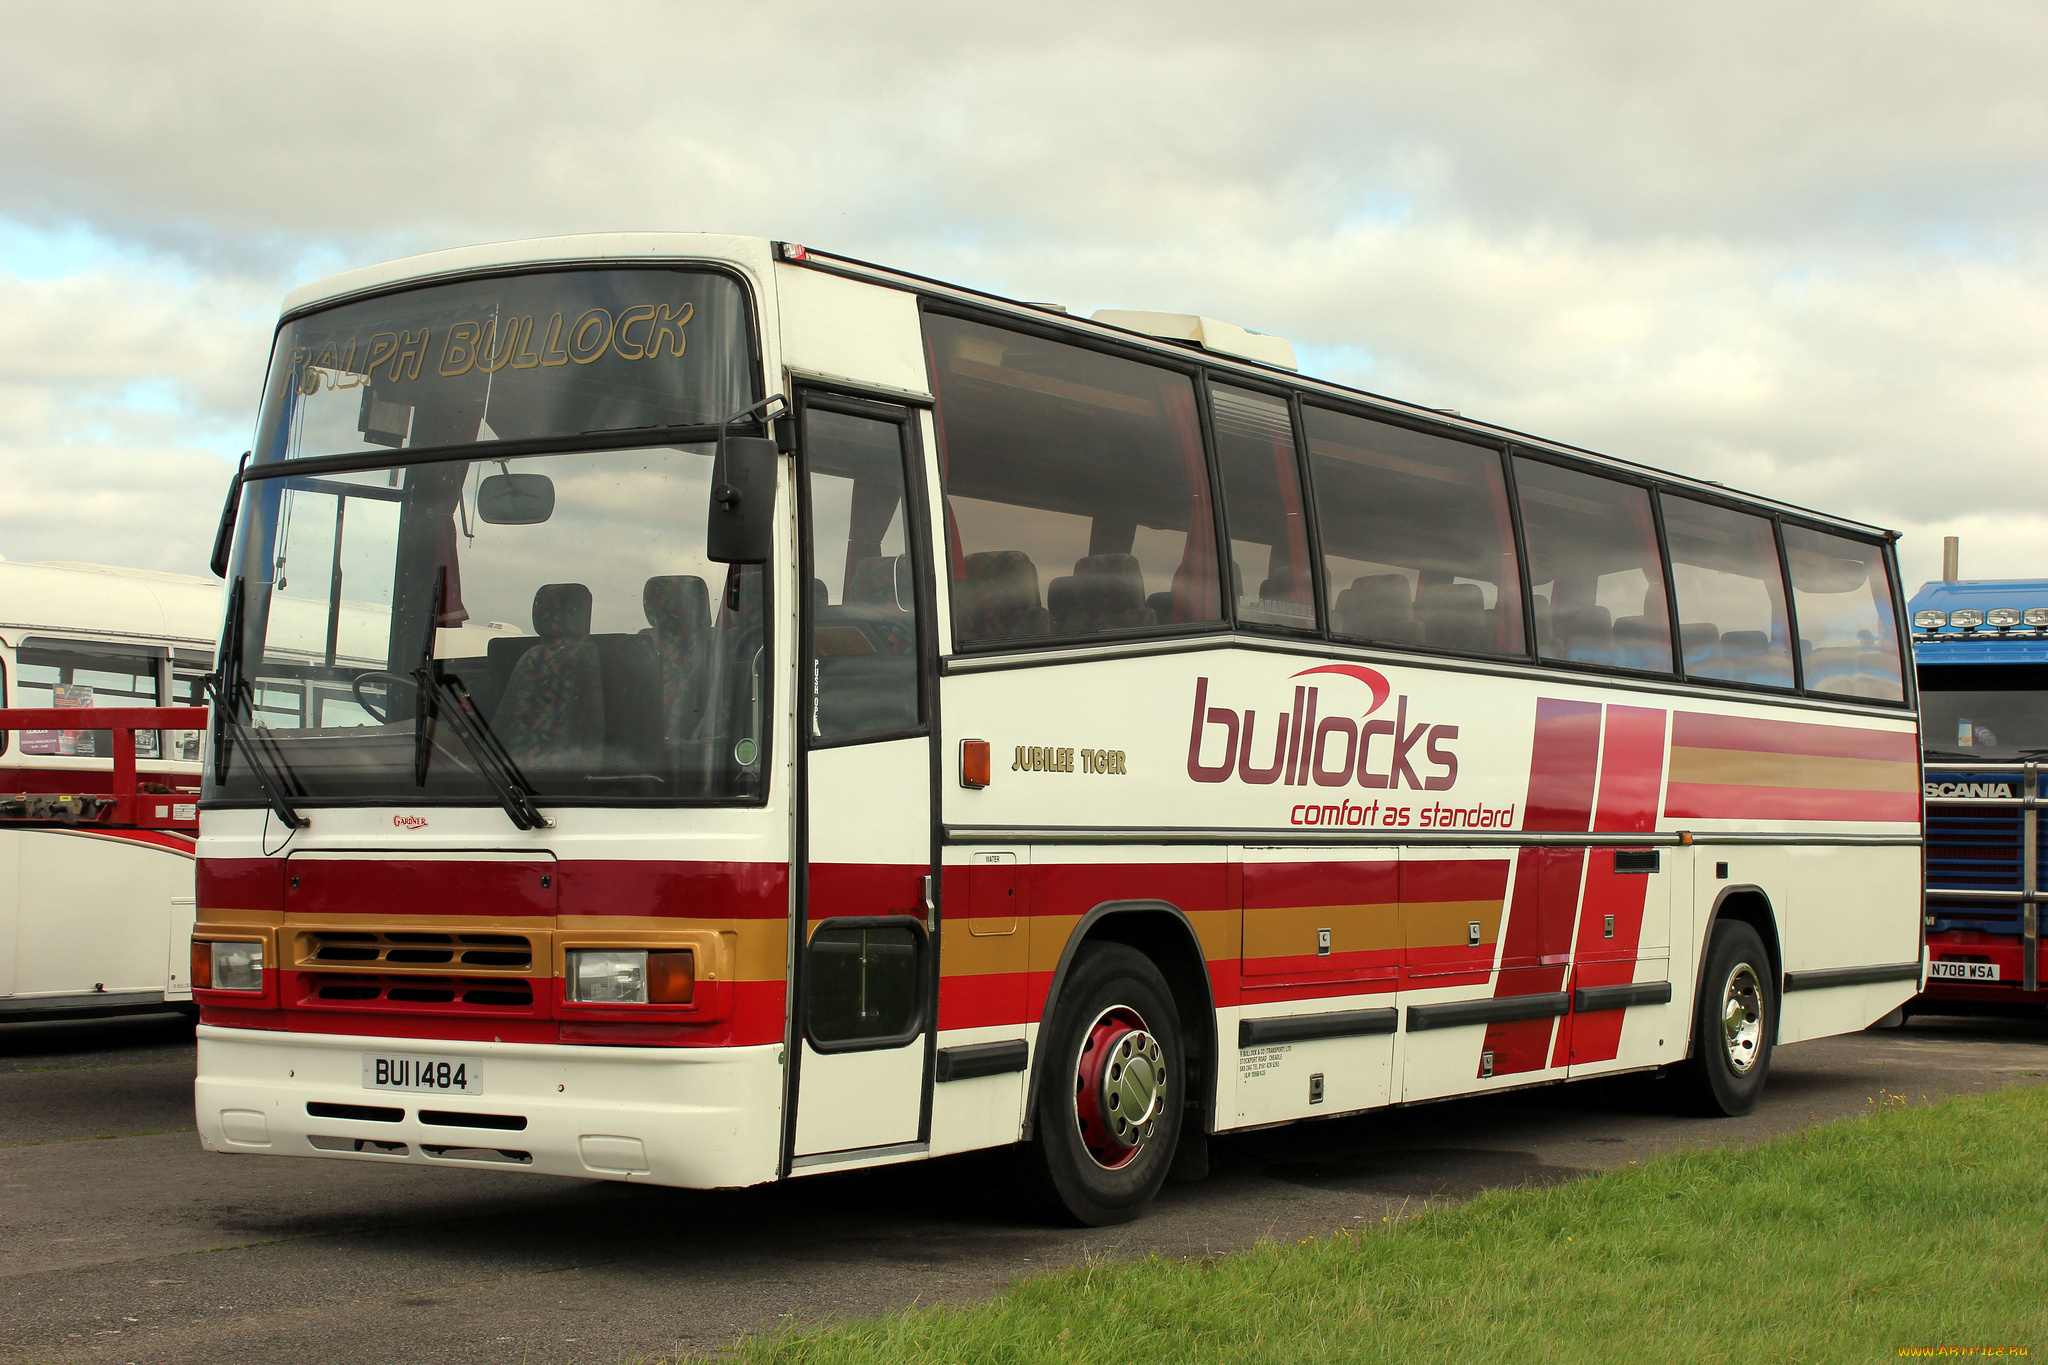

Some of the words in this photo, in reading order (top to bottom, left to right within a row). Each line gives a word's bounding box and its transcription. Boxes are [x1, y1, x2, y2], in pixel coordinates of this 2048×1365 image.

[278, 328, 429, 399] RALPH
[439, 302, 694, 377] BULLOCK
[1187, 677, 1459, 791] bullocks
[1011, 746, 1074, 773] JUBILEE
[1081, 749, 1127, 774] TIGER
[1925, 782, 2012, 798] SCANIA
[1291, 799, 1379, 826] comfort
[1383, 806, 1410, 827] as
[1420, 801, 1515, 828] standard
[1932, 964, 1966, 977] N708
[1969, 966, 1994, 978] WSA
